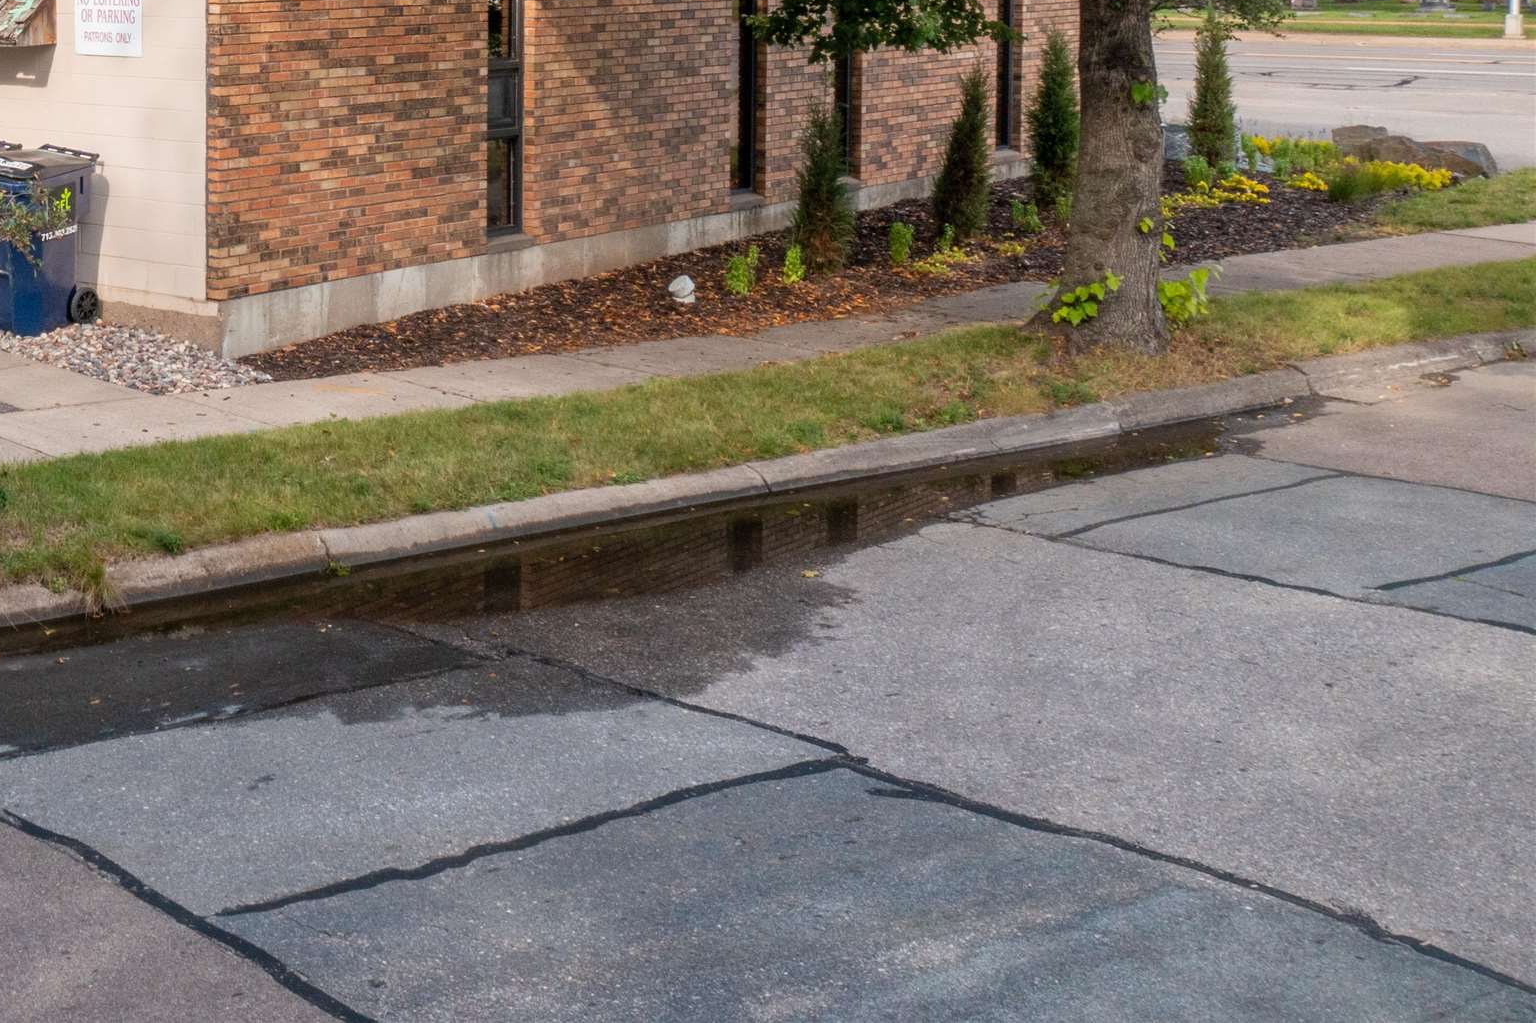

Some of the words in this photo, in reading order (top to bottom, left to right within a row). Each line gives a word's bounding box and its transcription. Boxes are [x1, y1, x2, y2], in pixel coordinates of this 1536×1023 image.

[81, 8, 93, 23] OR
[96, 9, 136, 24] PARKING
[83, 31, 113, 43] PATRONS
[115, 32, 132, 44] ONLY
